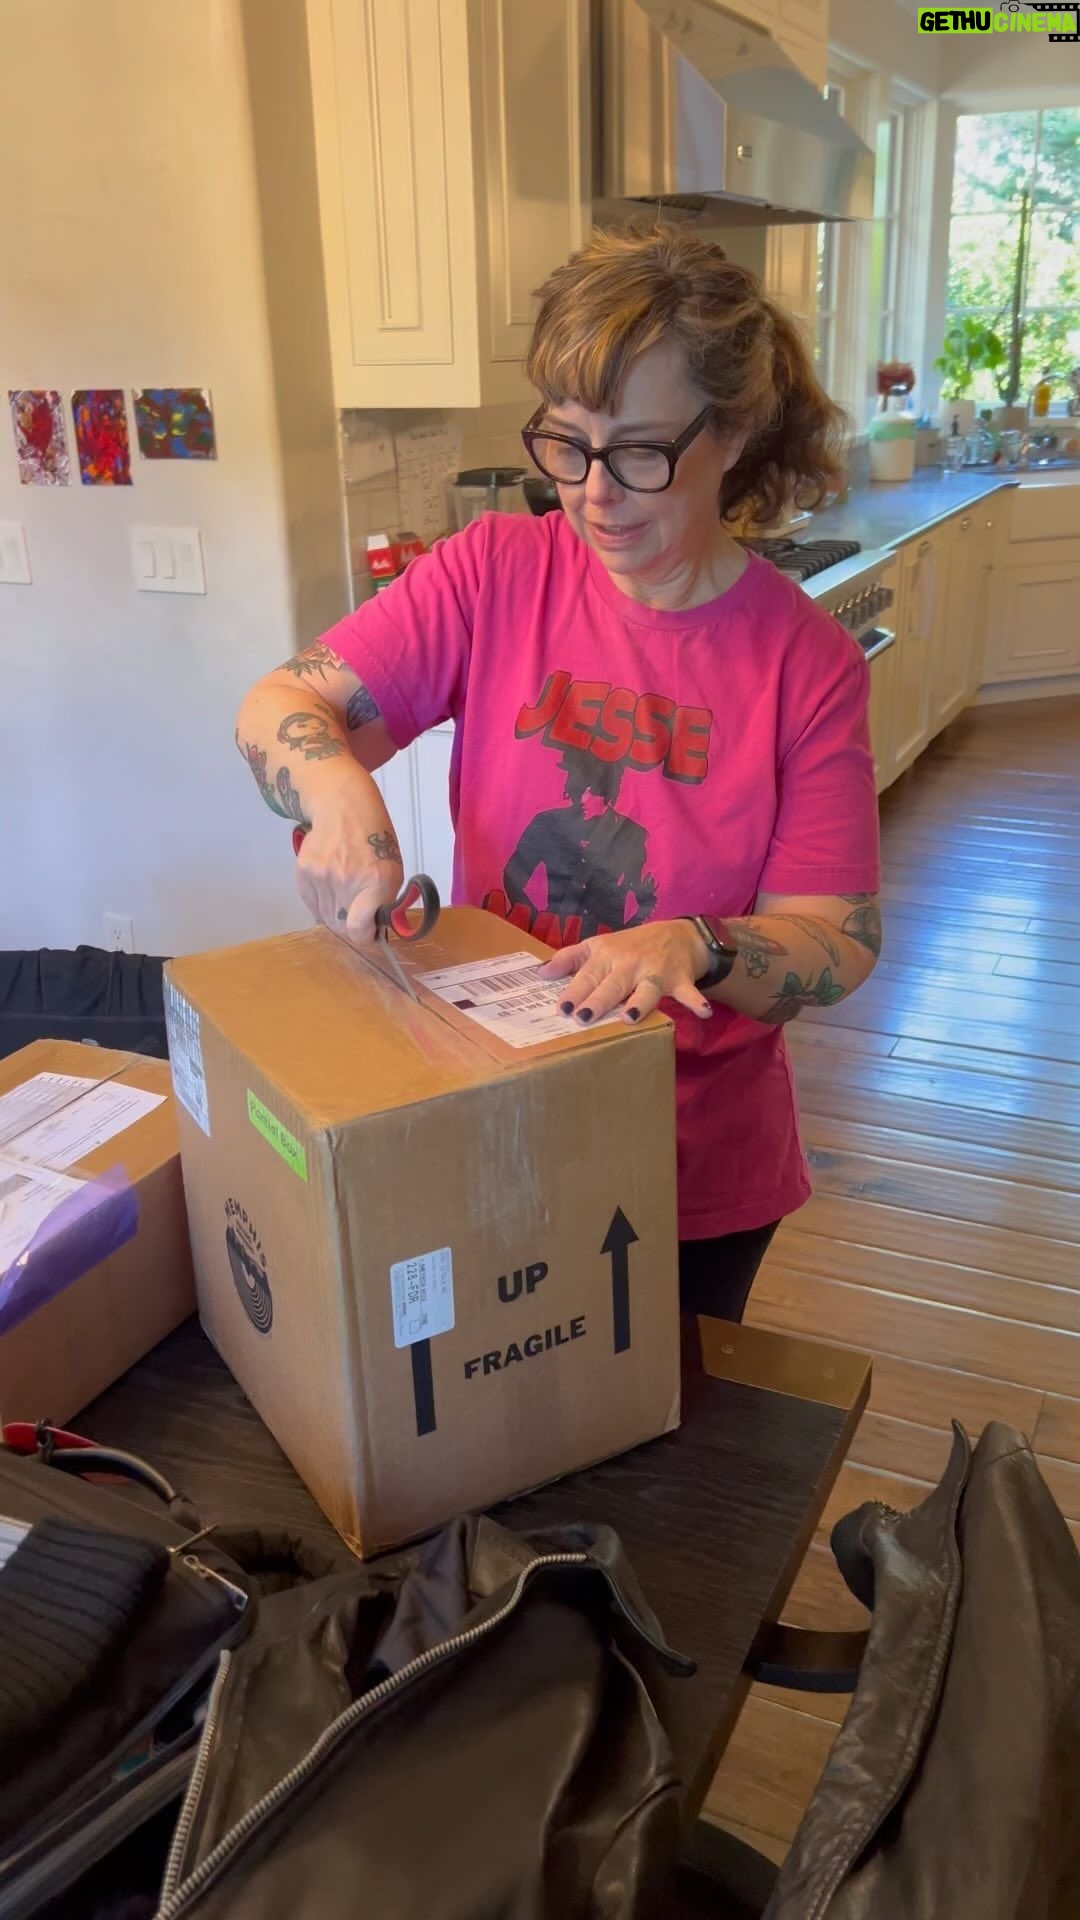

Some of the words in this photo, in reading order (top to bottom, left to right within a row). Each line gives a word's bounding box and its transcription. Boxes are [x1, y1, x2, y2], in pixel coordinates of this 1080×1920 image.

[514, 670, 714, 785] JESSE
[280, 1131, 299, 1159] Box
[497, 1261, 549, 1304] UP
[464, 1315, 587, 1380] FRAGILE
